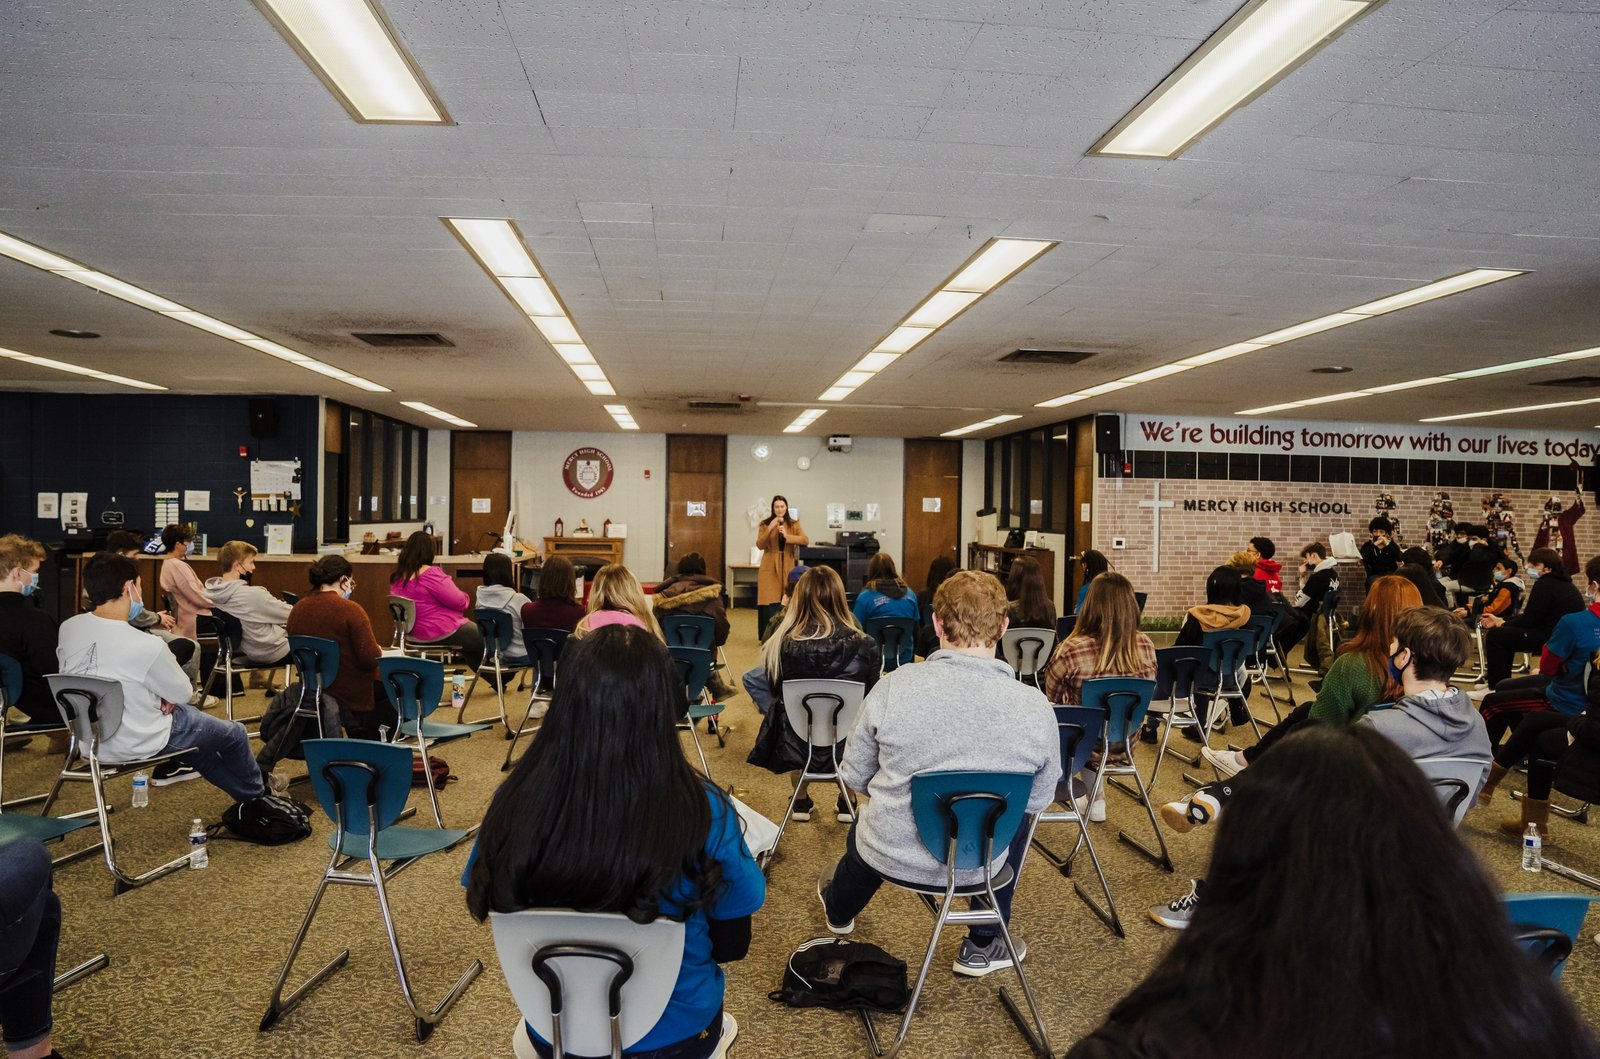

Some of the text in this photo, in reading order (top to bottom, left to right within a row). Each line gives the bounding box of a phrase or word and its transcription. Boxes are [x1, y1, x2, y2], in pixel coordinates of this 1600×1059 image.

[1140, 421, 1600, 462] We're building tomorrow with our lives today
[565, 452, 578, 470] MERCY
[597, 451, 612, 471] SCHOOL
[572, 487, 593, 497] Founded
[1183, 499, 1352, 515] MERCY HIGH SCHOOL
